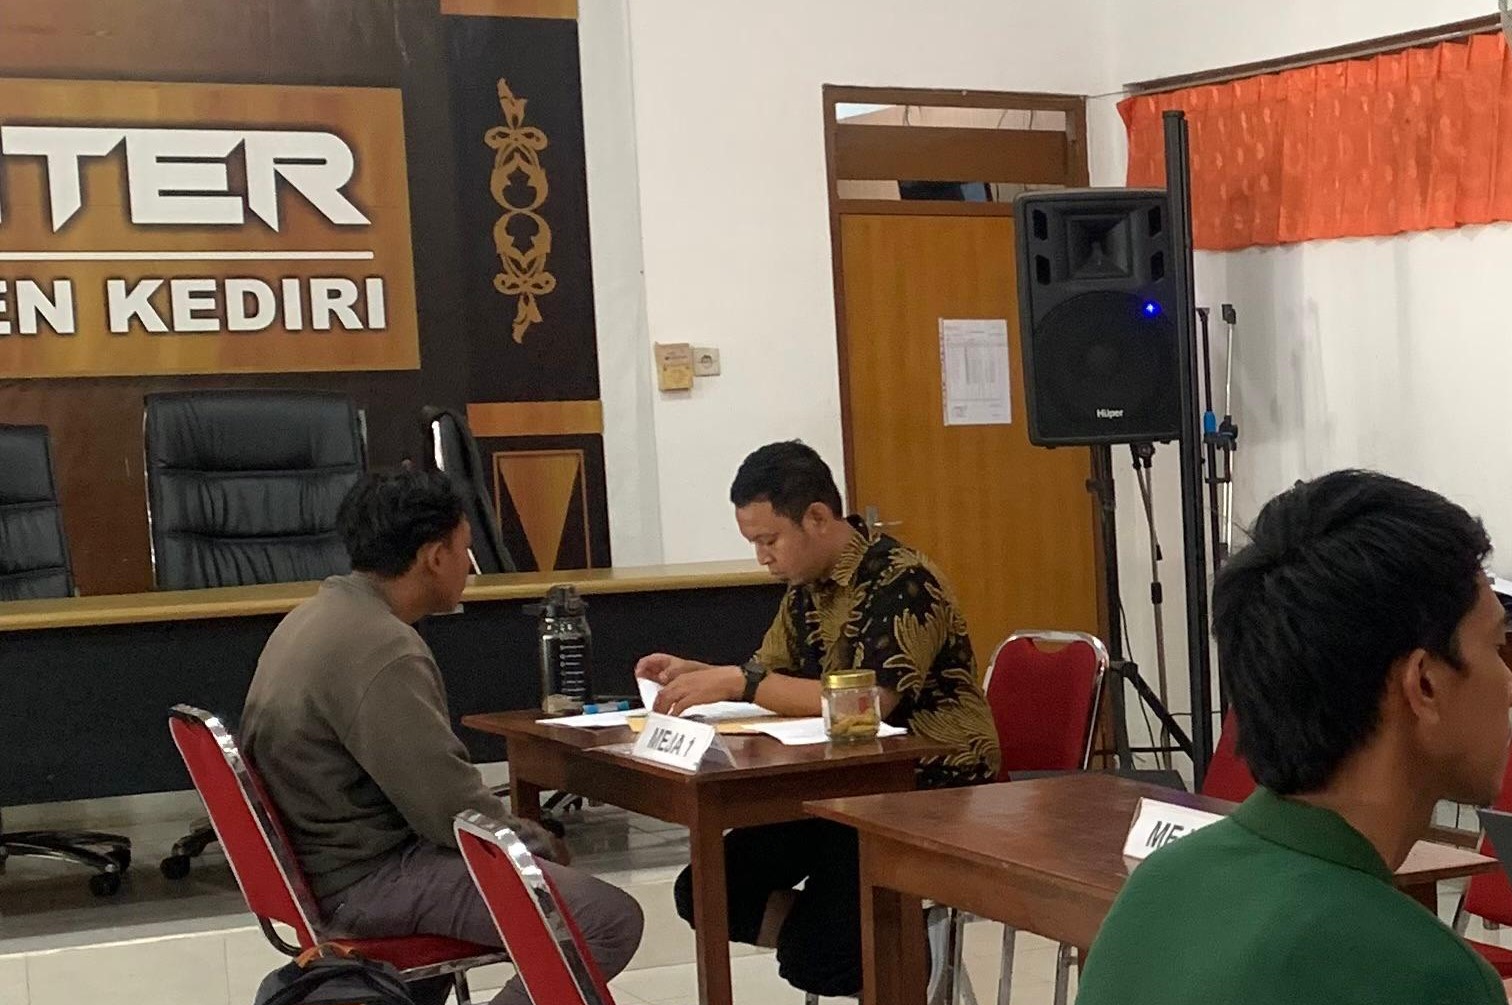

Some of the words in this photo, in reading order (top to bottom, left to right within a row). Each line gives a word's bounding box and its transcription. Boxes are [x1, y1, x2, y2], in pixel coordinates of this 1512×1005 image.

[0, 126, 372, 232] TER
[106, 277, 386, 334] KEDIRI
[647, 727, 685, 755] MEJA
[683, 737, 696, 757] 1
[1145, 820, 1194, 848] ME
